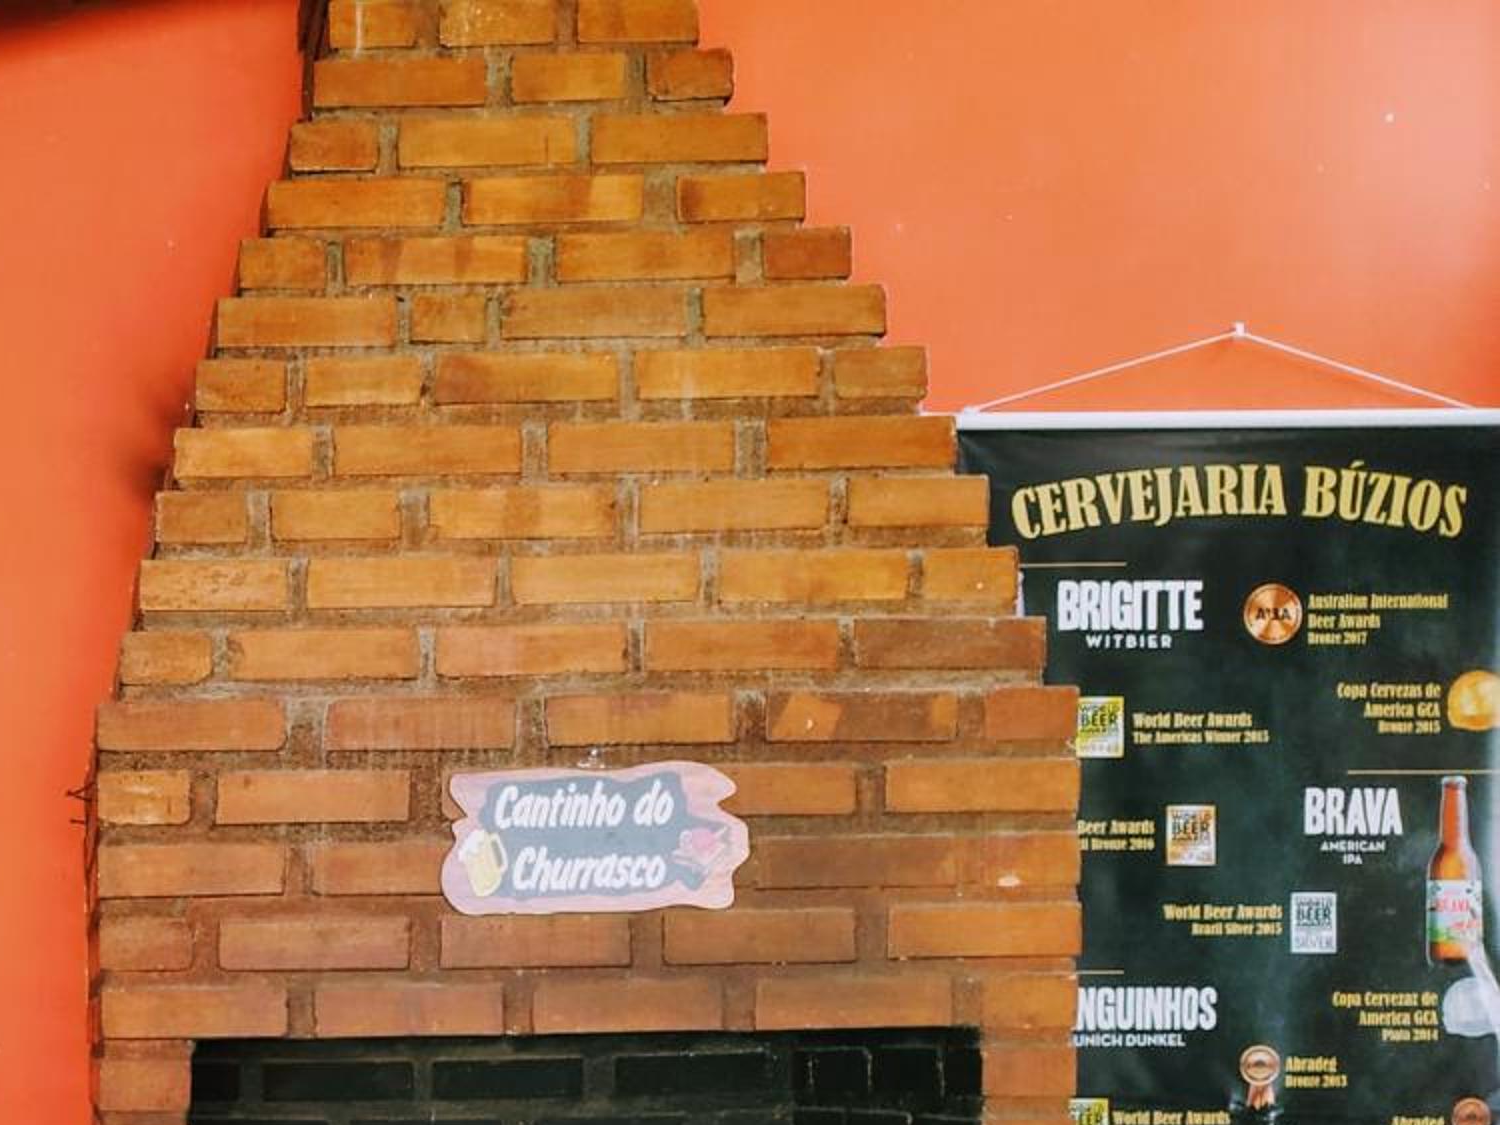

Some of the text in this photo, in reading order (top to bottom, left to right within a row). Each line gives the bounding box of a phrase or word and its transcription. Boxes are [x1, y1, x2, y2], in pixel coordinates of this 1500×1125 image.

[1011, 458, 1468, 540] CERVEJARIA BÚZIOS
[1057, 579, 1204, 631] BRIGITTE
[1308, 613, 1381, 629] Beer Awards
[1085, 634, 1173, 648] WITBIER
[1337, 682, 1441, 699] Copa Cervezas de
[1364, 702, 1414, 718] America
[1132, 712, 1252, 729] World Beer Awards
[493, 778, 676, 830] Cantinho do
[1304, 787, 1403, 835] BRAVA
[1077, 819, 1155, 835] Beer Awards
[1320, 840, 1386, 852] AMERICAN
[1343, 853, 1363, 865] IPA
[511, 845, 667, 892] Churrasco
[1163, 904, 1283, 920] World Beer Awards
[1332, 991, 1361, 1008] Copa
[1421, 991, 1439, 1007] de
[1359, 1010, 1411, 1025] America
[1070, 1033, 1186, 1047] UNICH DUNKEL
[1153, 1110, 1183, 1125] Beer
[1186, 1110, 1231, 1125] Awards
